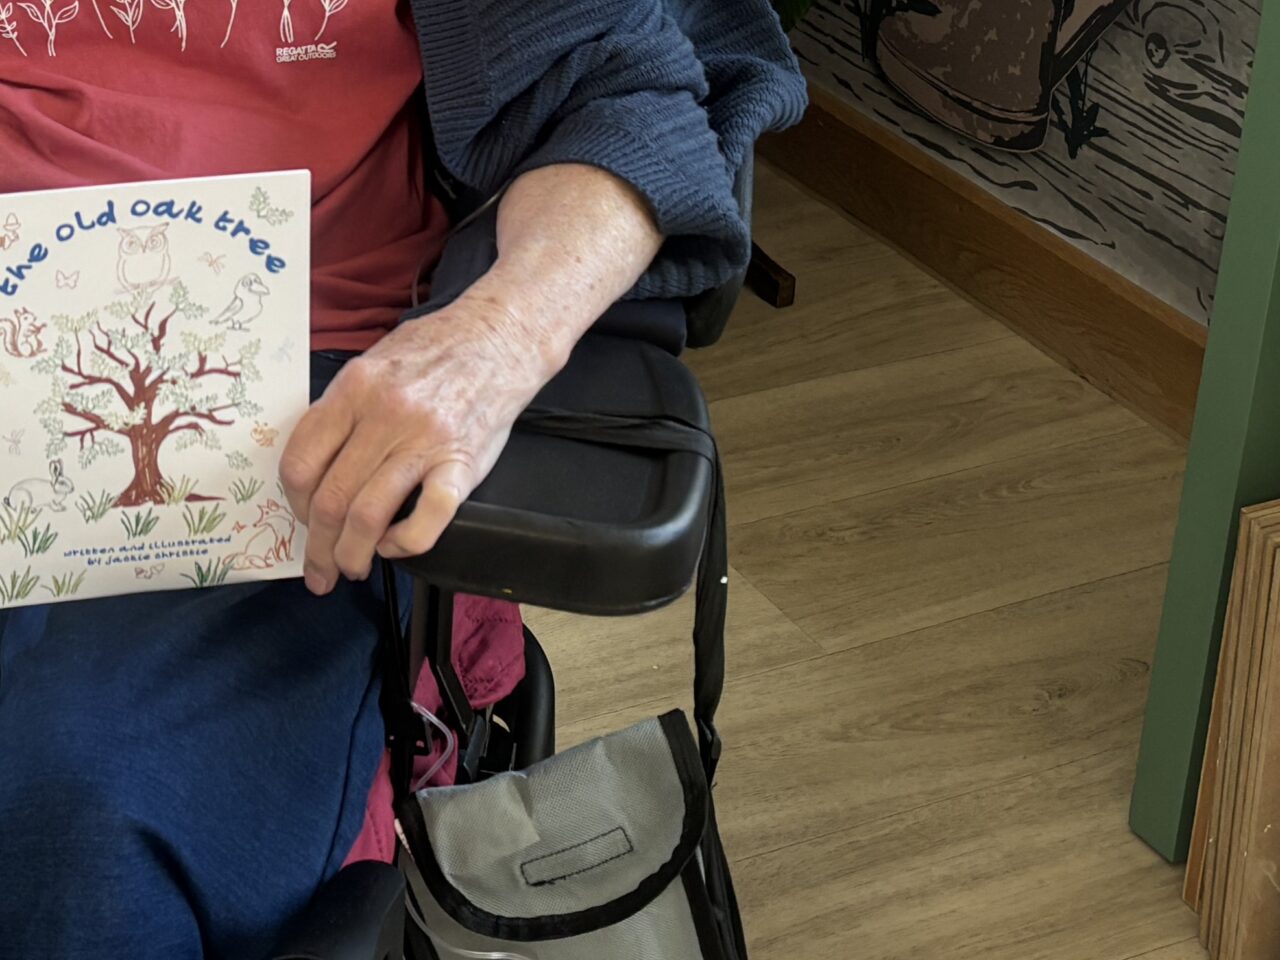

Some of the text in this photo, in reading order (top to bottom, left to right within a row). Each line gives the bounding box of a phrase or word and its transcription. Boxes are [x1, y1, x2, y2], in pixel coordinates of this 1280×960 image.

[276, 45, 316, 56] REGATTA
[55, 200, 116, 242] old
[130, 198, 203, 223] oak
[213, 211, 287, 274] tree
[63, 535, 232, 557] written and illustrated
